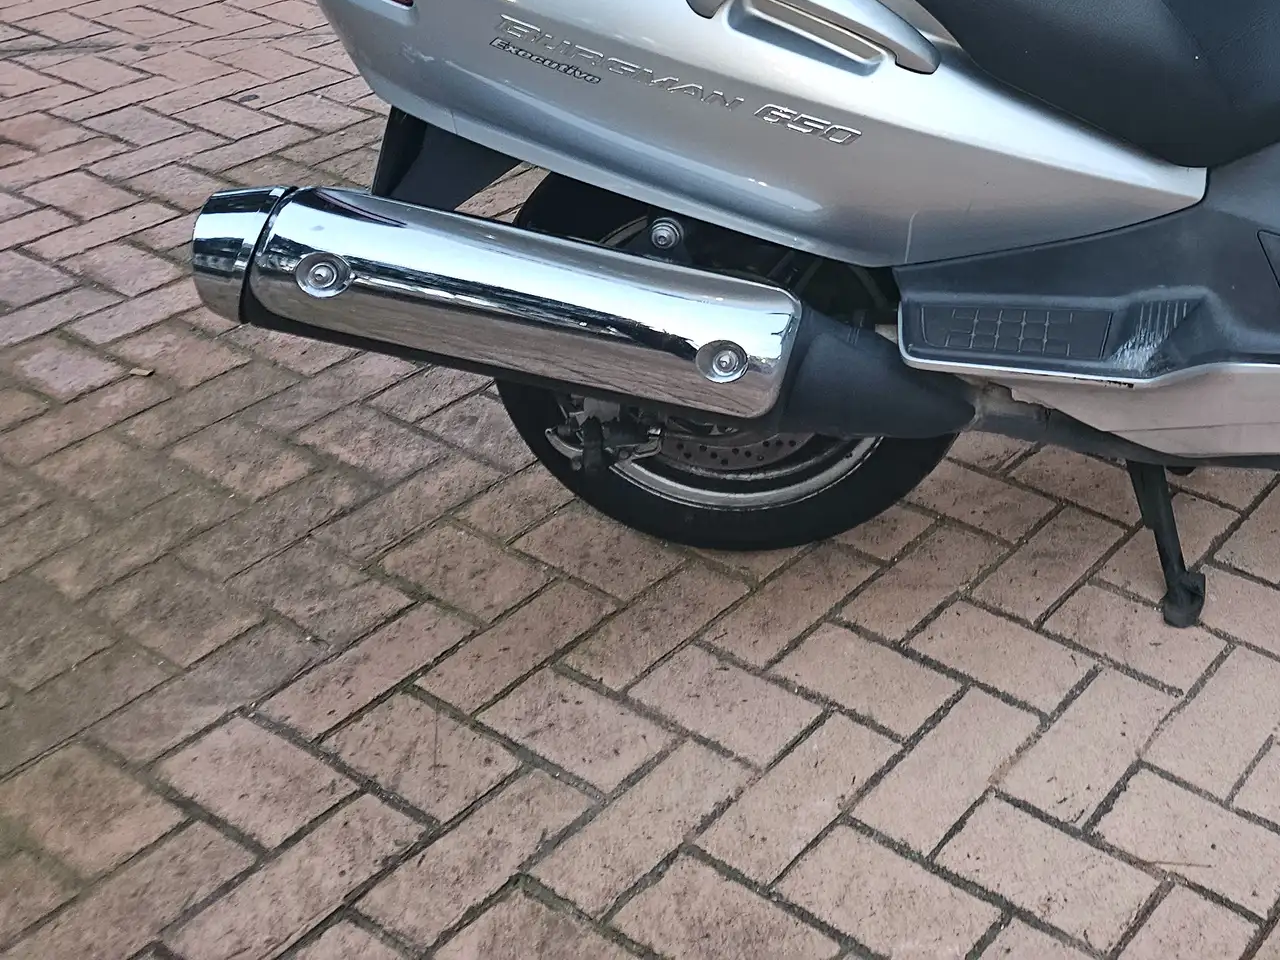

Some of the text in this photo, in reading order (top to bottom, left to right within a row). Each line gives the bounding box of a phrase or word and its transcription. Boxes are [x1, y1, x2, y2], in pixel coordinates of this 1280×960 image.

[489, 36, 601, 85] Executive
[496, 13, 861, 145] BURGMAN 650
